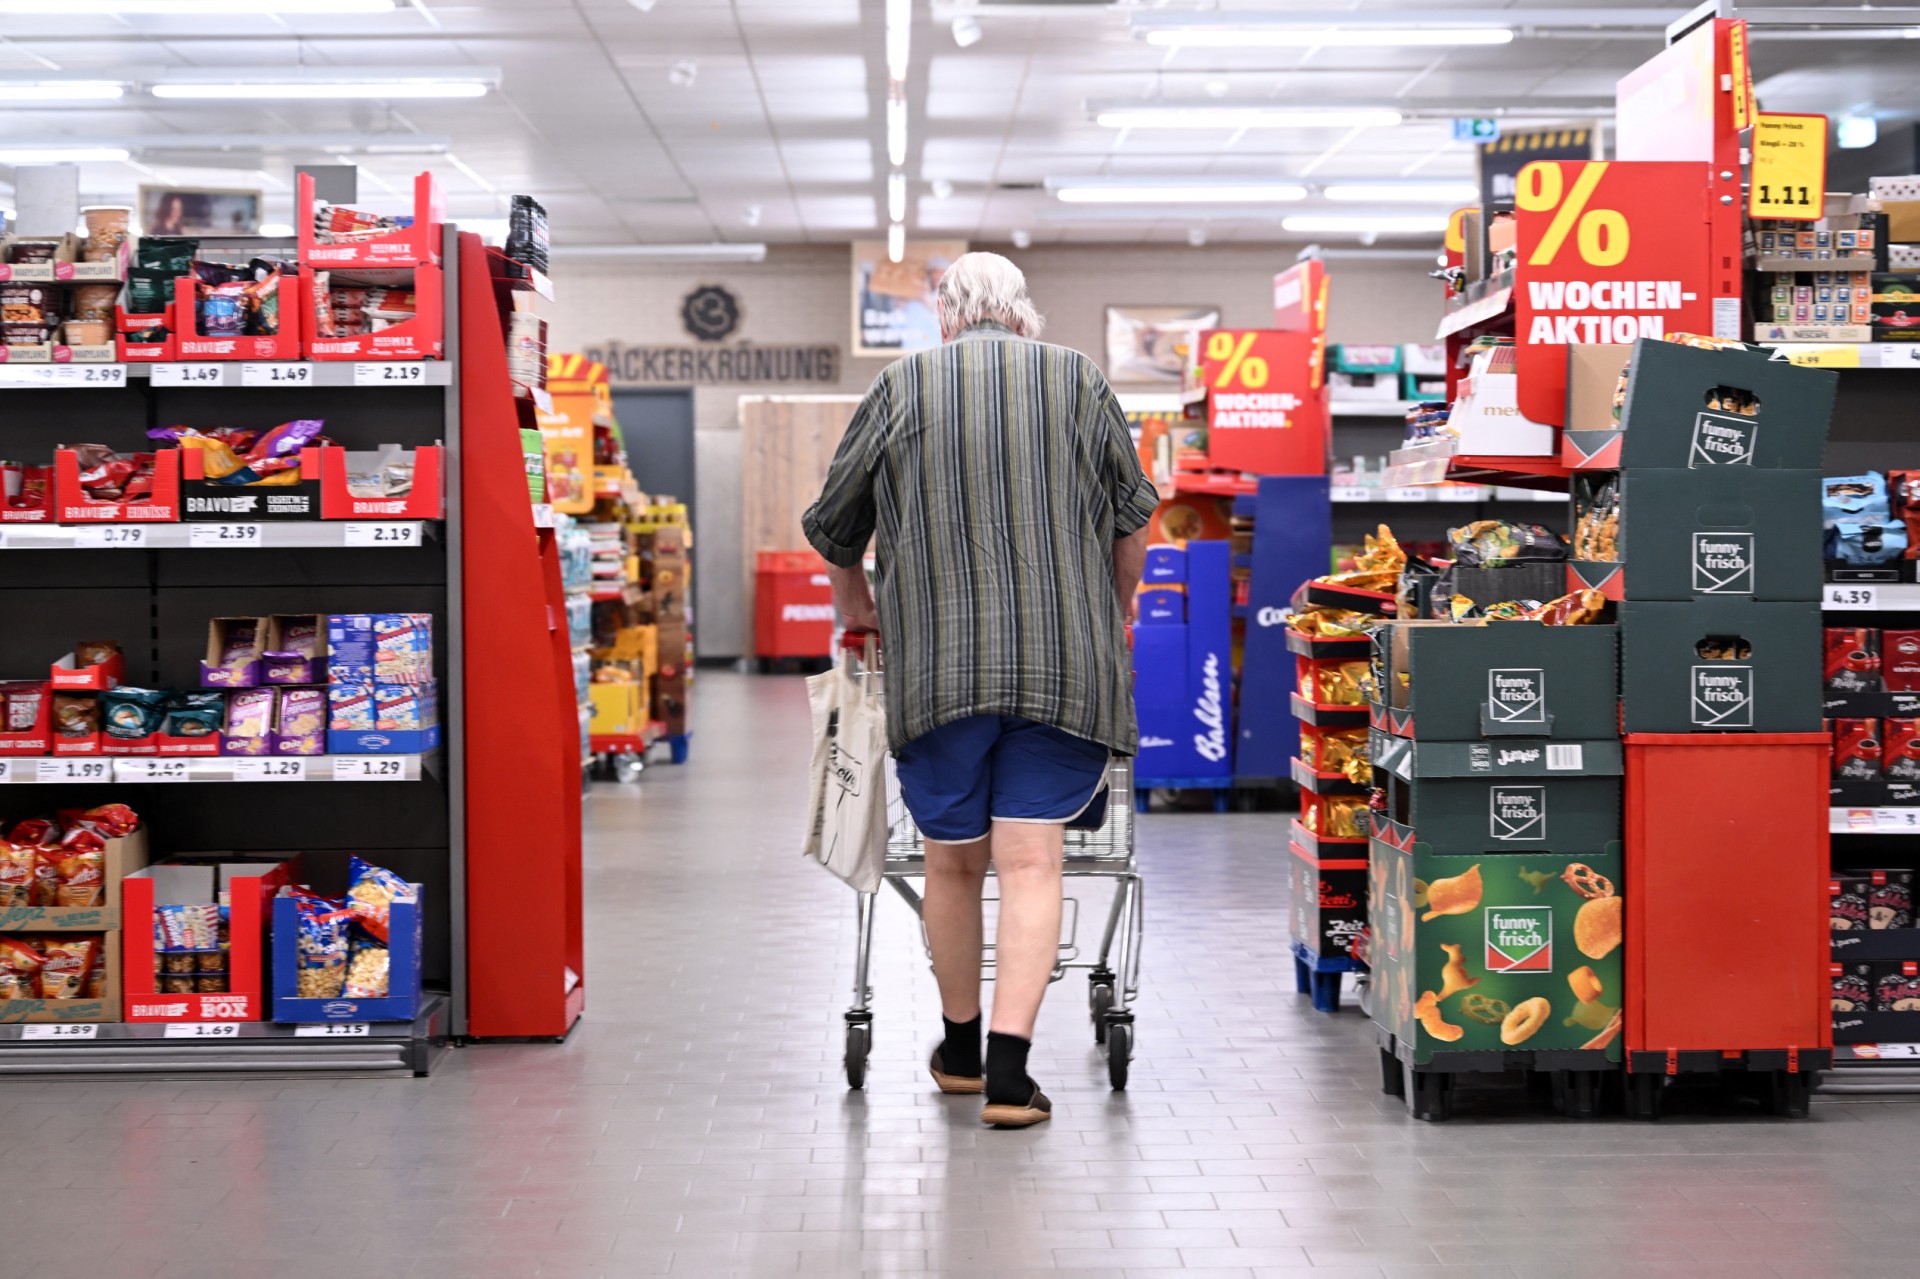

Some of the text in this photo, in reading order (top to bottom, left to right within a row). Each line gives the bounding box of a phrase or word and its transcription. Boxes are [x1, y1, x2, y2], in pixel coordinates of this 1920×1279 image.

[1759, 185, 1810, 205] 1.11
[1516, 162, 1631, 266] %
[1528, 281, 1697, 310] WOCHEN-
[1528, 316, 1665, 344] AKTION
[1207, 333, 1269, 388] %
[85, 368, 121, 381] 2.99
[182, 368, 219, 380] 1.49
[271, 368, 307, 380] 1.49
[384, 367, 420, 379] 2.19
[1214, 393, 1302, 411] WOCHEN-
[1483, 406, 1519, 416] mer
[1702, 420, 1745, 442] funny-
[1705, 436, 1744, 456] frisch
[187, 497, 231, 512] BRAVO
[219, 526, 256, 538] 2.39
[374, 528, 411, 540] 2.19
[1699, 539, 1745, 558] funny-
[1705, 554, 1745, 570] frisch
[1832, 590, 1872, 603] 4.39
[207, 671, 231, 682] Chio
[268, 667, 291, 677] Chio
[1495, 675, 1535, 690] funny-
[1699, 672, 1742, 690] funny-
[290, 690, 319, 701] Chio
[1500, 689, 1536, 701] frisch
[1704, 687, 1744, 702] frisch
[1193, 652, 1226, 762] Bahlsen
[226, 738, 249, 750] Chio
[279, 738, 302, 750] Chio
[66, 763, 104, 776] 1.99
[263, 762, 300, 775] 1.29
[363, 761, 400, 775] 1.29
[1496, 791, 1536, 807] funny-
[1501, 805, 1537, 818] frisch
[1492, 914, 1541, 936] funny-
[1498, 930, 1542, 947] frisch
[201, 1003, 248, 1017] BOX
[54, 1025, 92, 1035] 1.89
[195, 1026, 234, 1035] 1.69
[326, 1025, 363, 1034] 1.15
